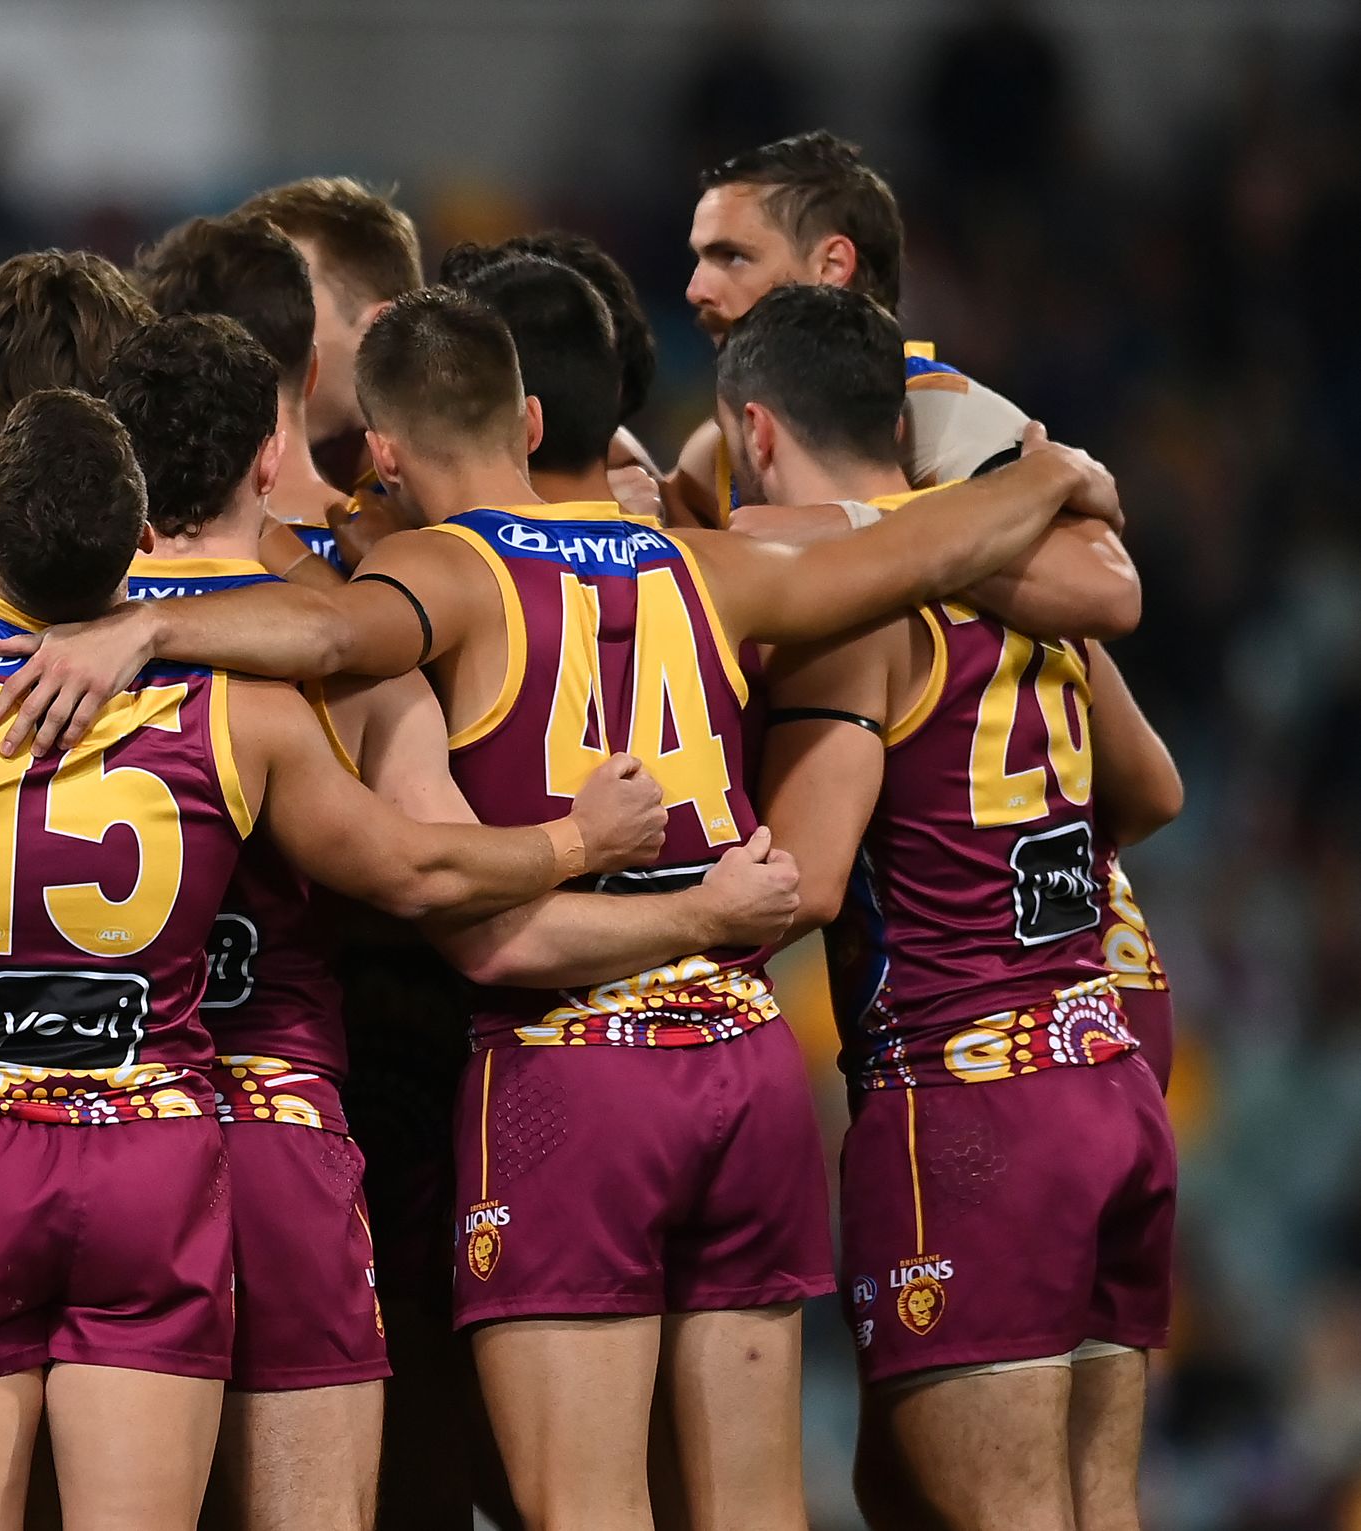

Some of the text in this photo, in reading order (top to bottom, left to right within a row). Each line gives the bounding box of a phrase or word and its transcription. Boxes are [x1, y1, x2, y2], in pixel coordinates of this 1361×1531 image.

[544, 566, 741, 848] 44
[99, 930, 129, 941] AFL
[465, 1205, 510, 1234] LIONS
[890, 1260, 954, 1288] LIONS
[899, 1254, 941, 1267] BRISBANE
